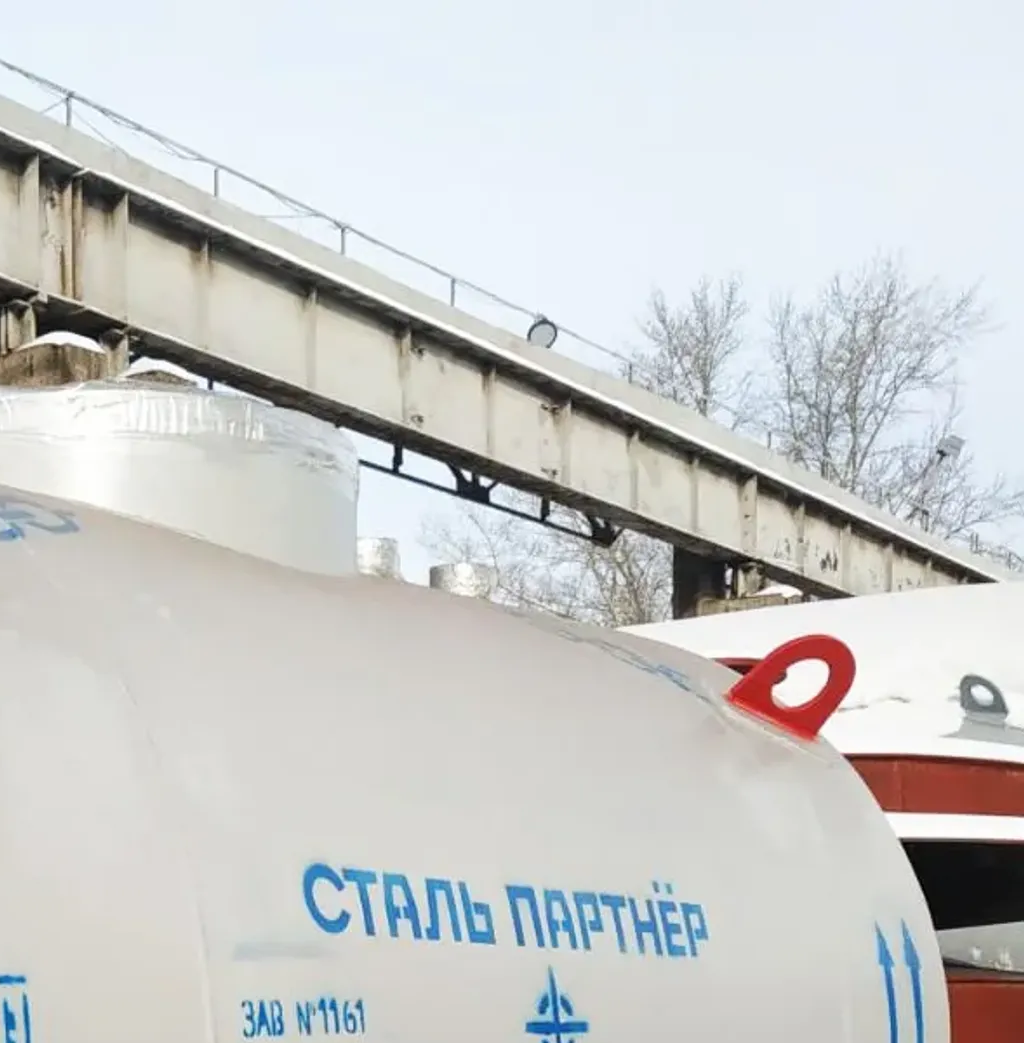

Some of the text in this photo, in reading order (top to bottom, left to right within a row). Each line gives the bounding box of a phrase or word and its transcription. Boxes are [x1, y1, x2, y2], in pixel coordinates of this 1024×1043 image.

[302, 862, 709, 957] СТАЛЬ ПАРТНЁР
[241, 1000, 284, 1038] ЗАВ
